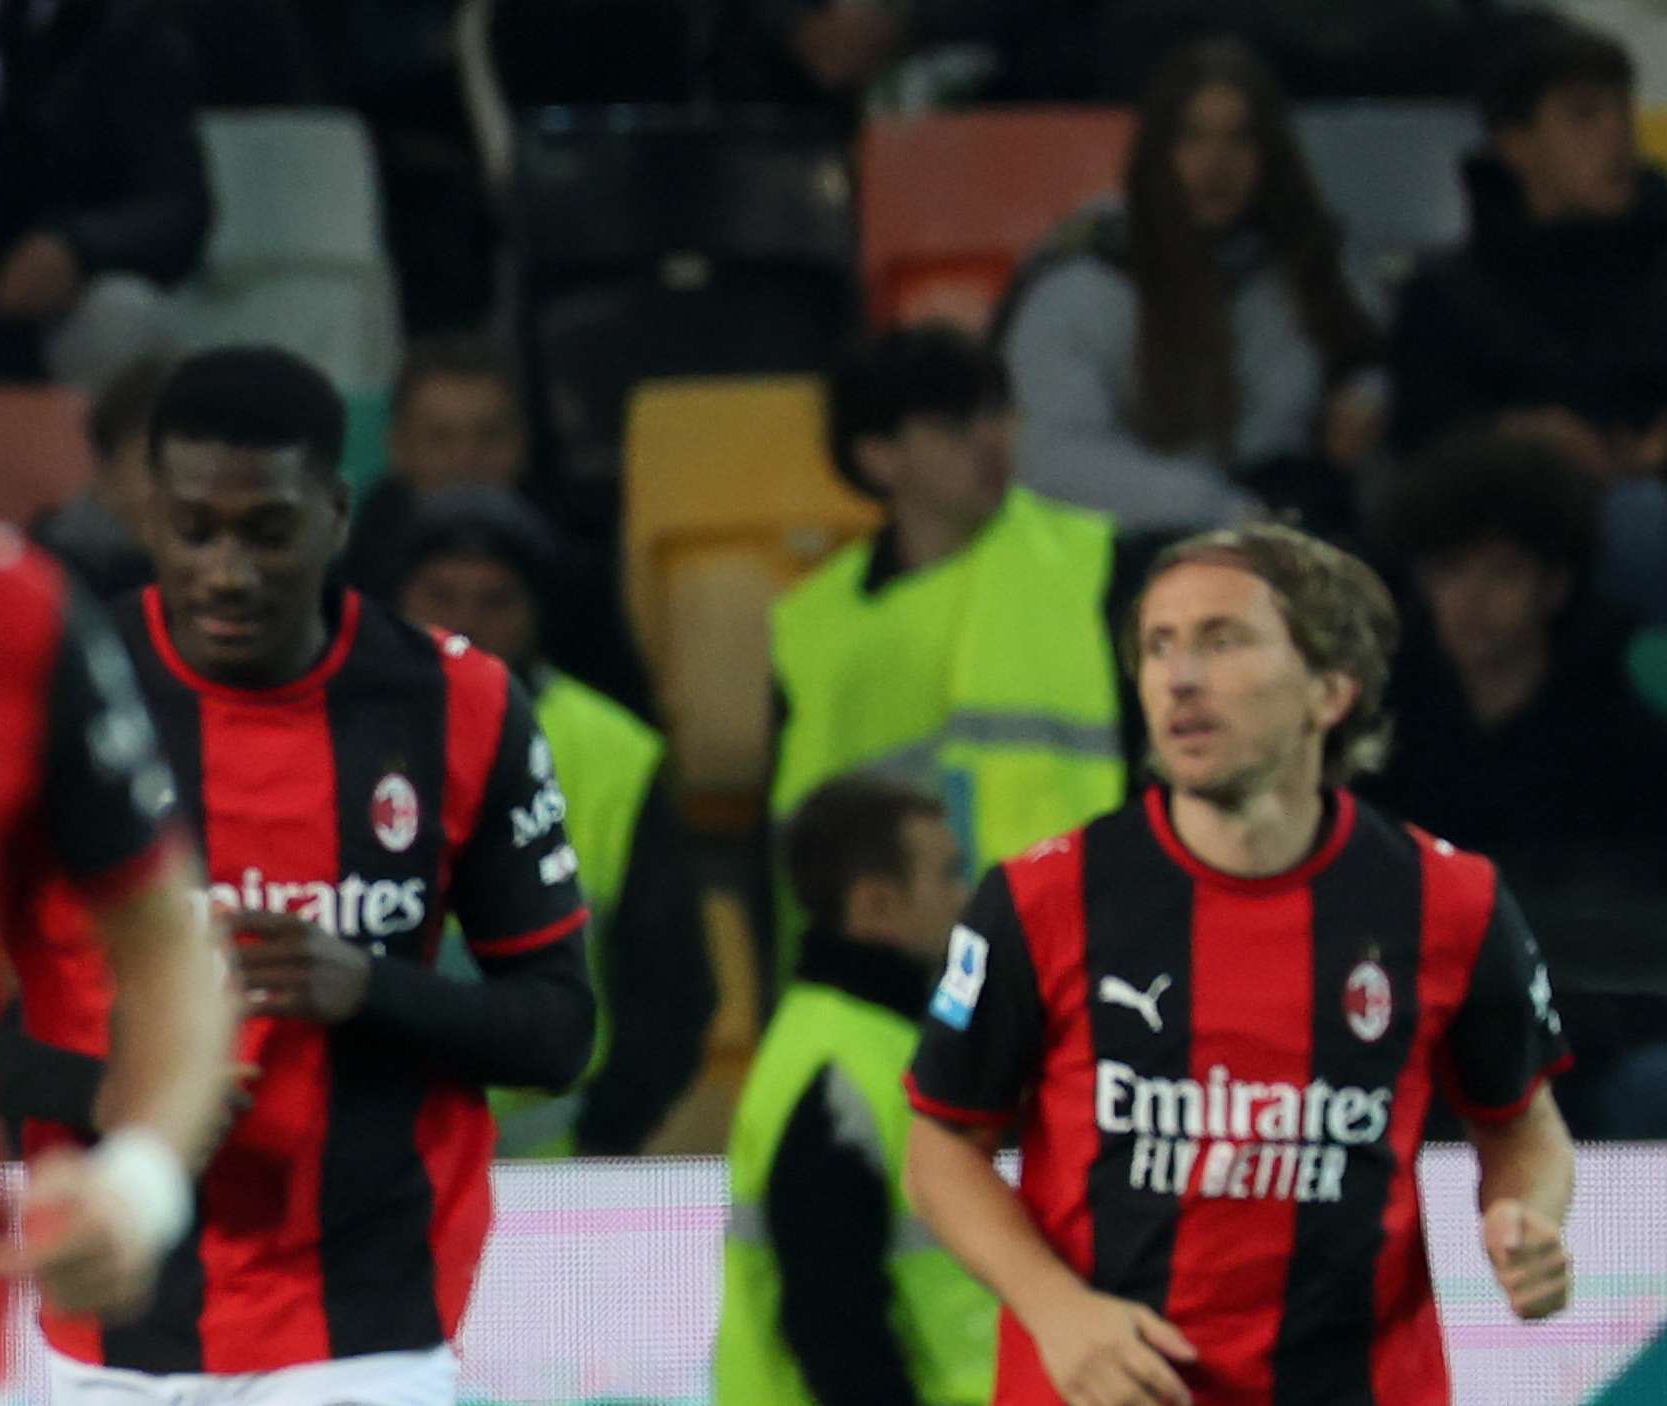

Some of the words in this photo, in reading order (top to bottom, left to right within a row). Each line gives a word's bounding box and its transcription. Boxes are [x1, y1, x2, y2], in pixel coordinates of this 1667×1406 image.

[1096, 1059, 1392, 1145] Emirates
[1129, 1135, 1201, 1195] FLY
[1199, 1141, 1348, 1202] BETTER
